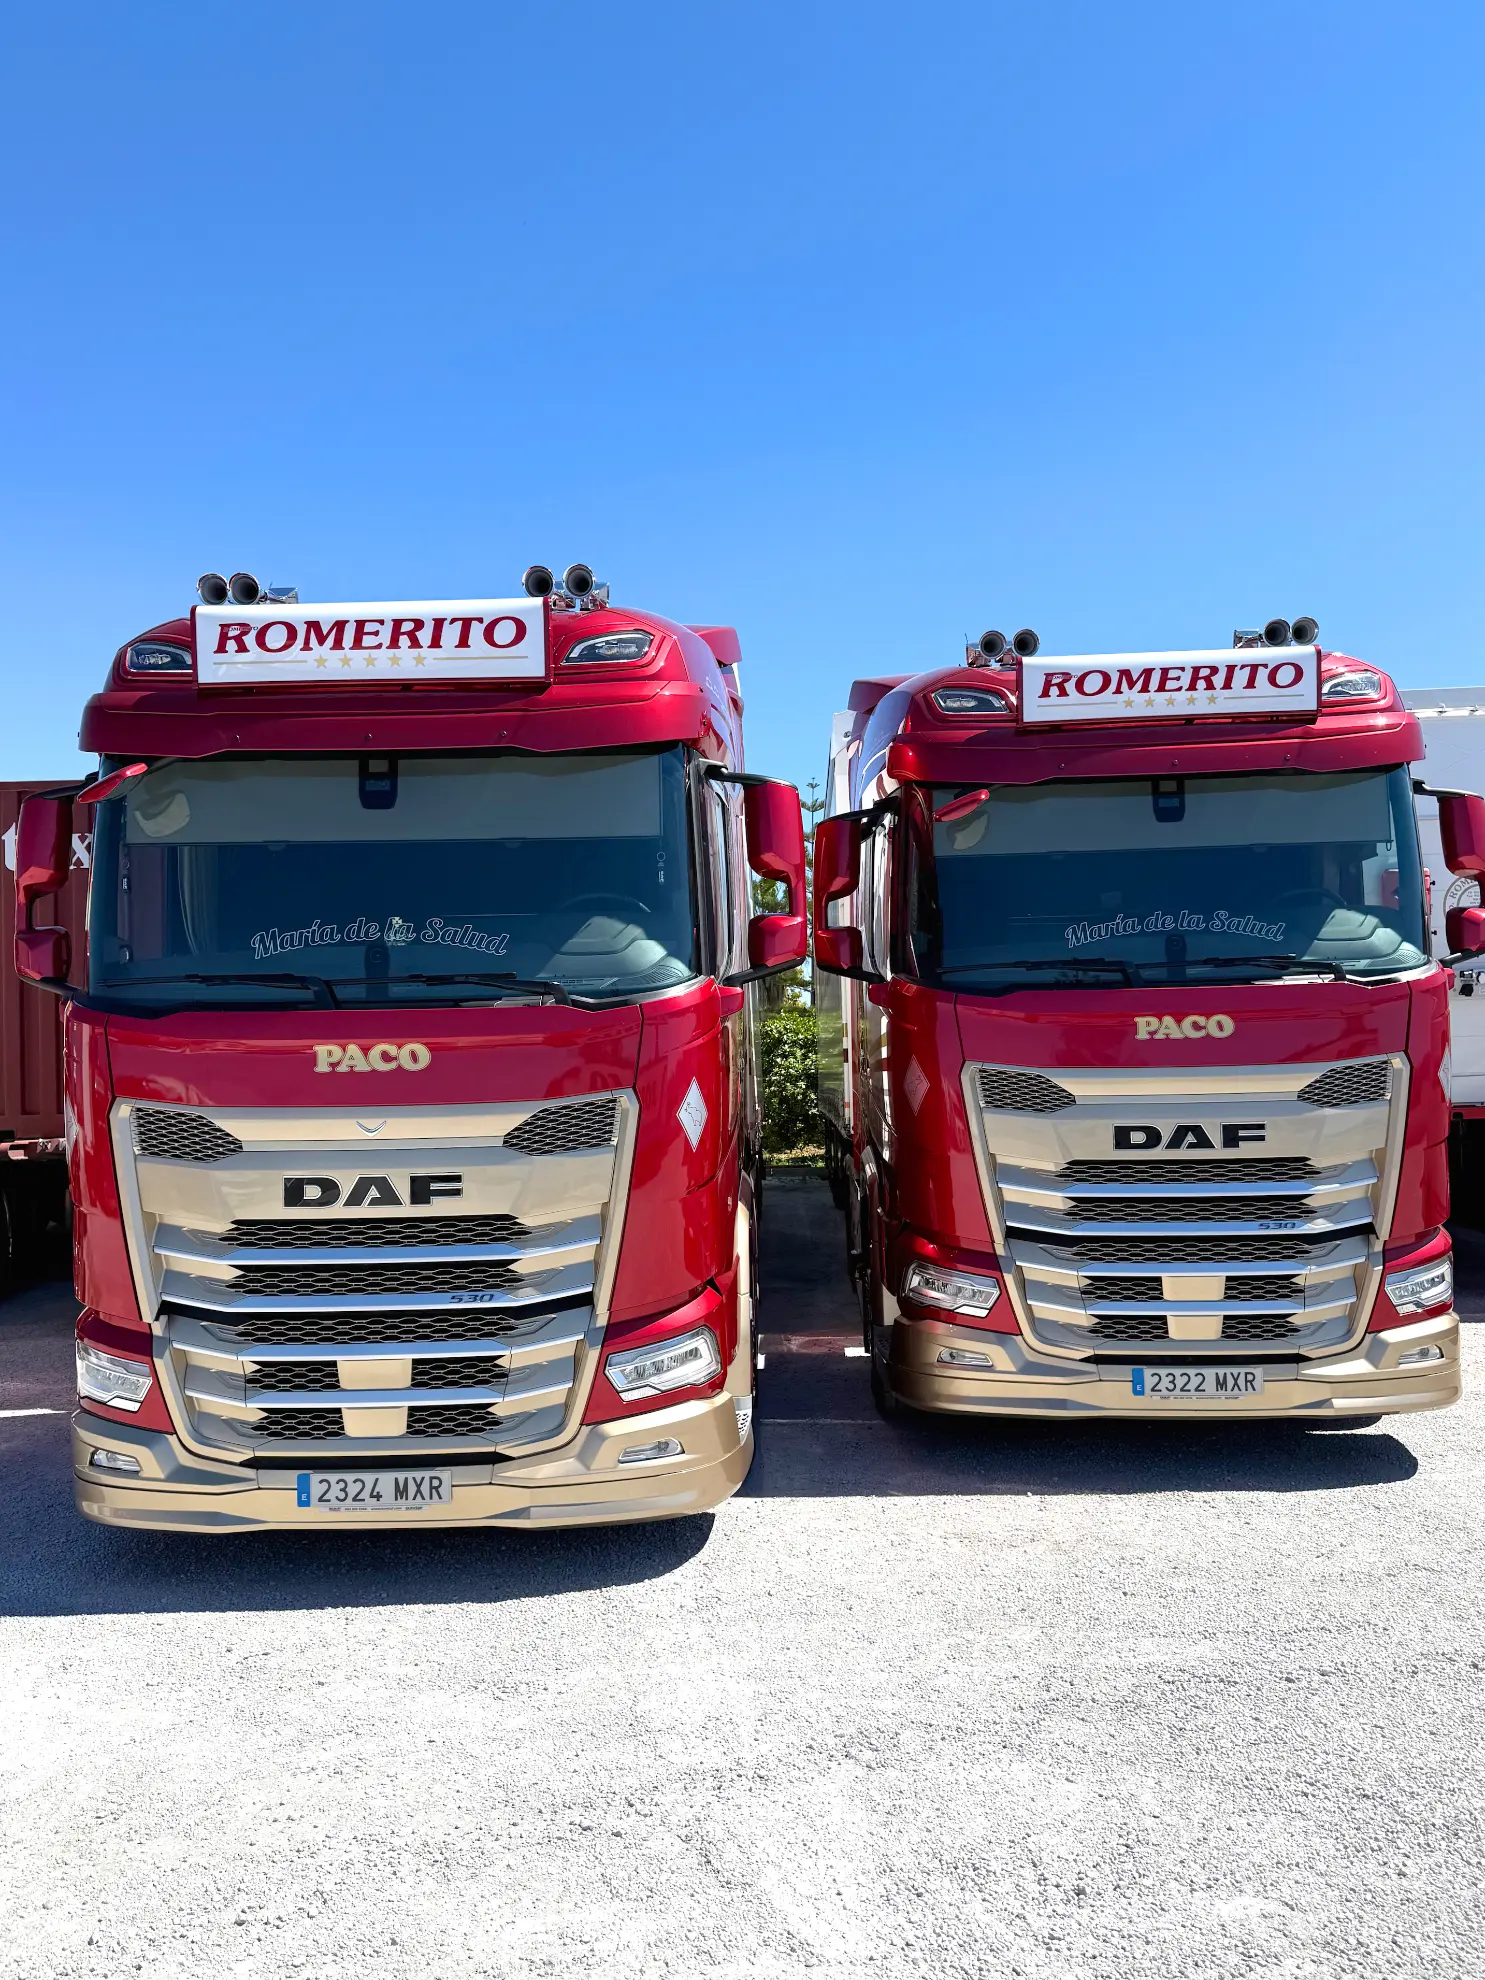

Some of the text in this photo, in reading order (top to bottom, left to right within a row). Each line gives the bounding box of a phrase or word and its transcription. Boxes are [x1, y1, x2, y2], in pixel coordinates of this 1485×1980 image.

[213, 616, 528, 654] ROMERITO
[1038, 661, 1304, 698] ROMERITO
[2, 822, 93, 872] tx
[251, 916, 510, 960] María de la Salud
[1065, 910, 1286, 948] María de la Salud
[1134, 1014, 1235, 1040] PACO
[312, 1042, 432, 1073] PACO
[1113, 1121, 1267, 1151] DAF
[283, 1172, 463, 1209] DAF
[449, 1293, 495, 1304] 530
[1150, 1372, 1206, 1393] 2322
[1215, 1371, 1256, 1392] MXR
[301, 1475, 443, 1503] E 2324 MXR
